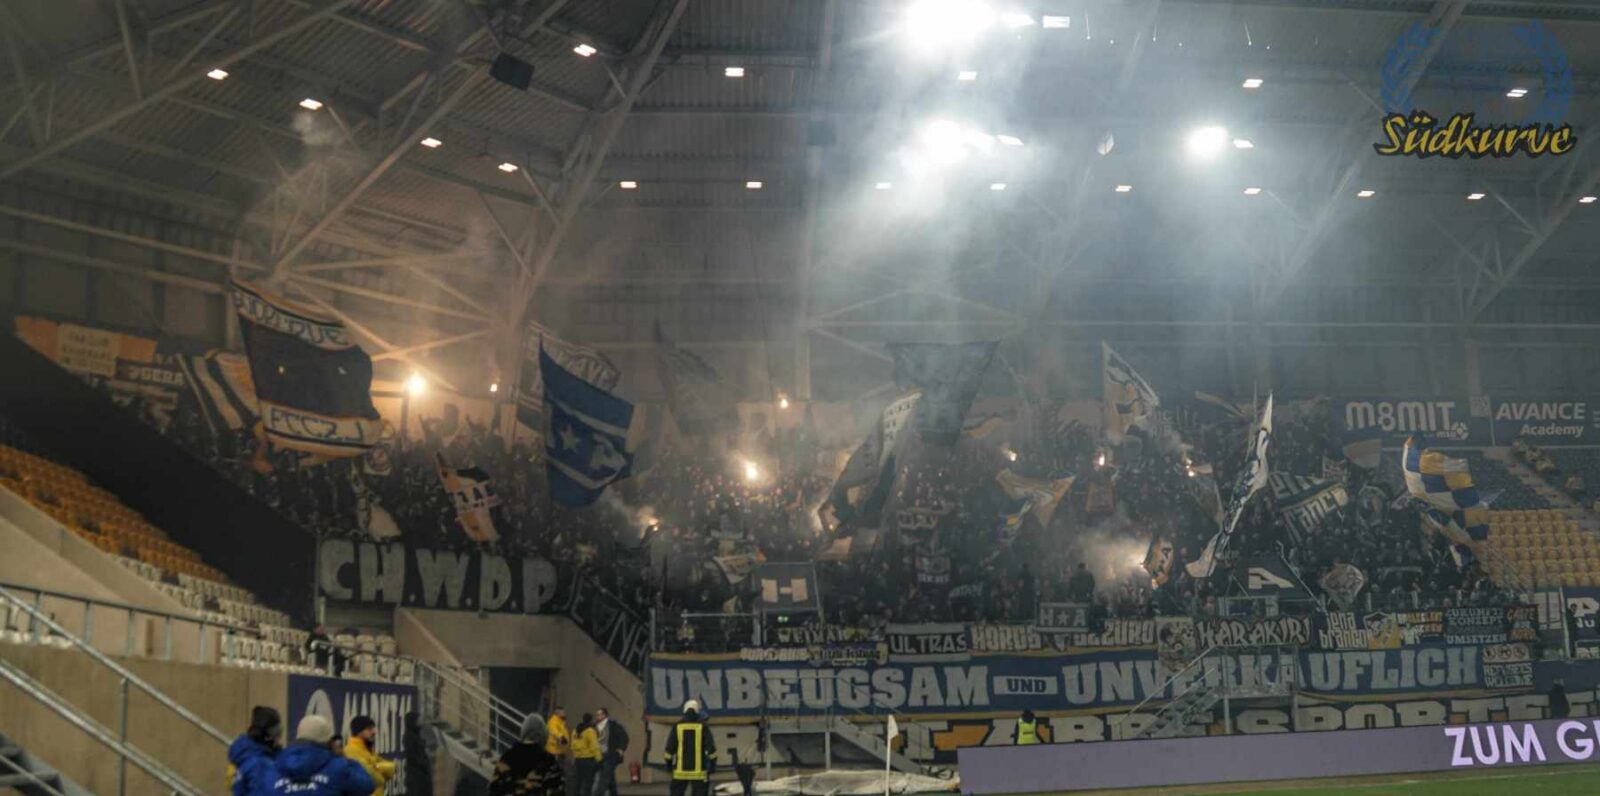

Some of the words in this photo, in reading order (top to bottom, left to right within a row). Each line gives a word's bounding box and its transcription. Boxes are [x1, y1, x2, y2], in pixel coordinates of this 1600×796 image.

[1495, 402, 1587, 422] AVANCE
[1520, 423, 1584, 441] Academy
[890, 632, 967, 654] ULTRAS
[651, 665, 990, 710] UNBEUGSAM
[1006, 678, 1047, 693] UND
[1444, 721, 1547, 767] ZUM
